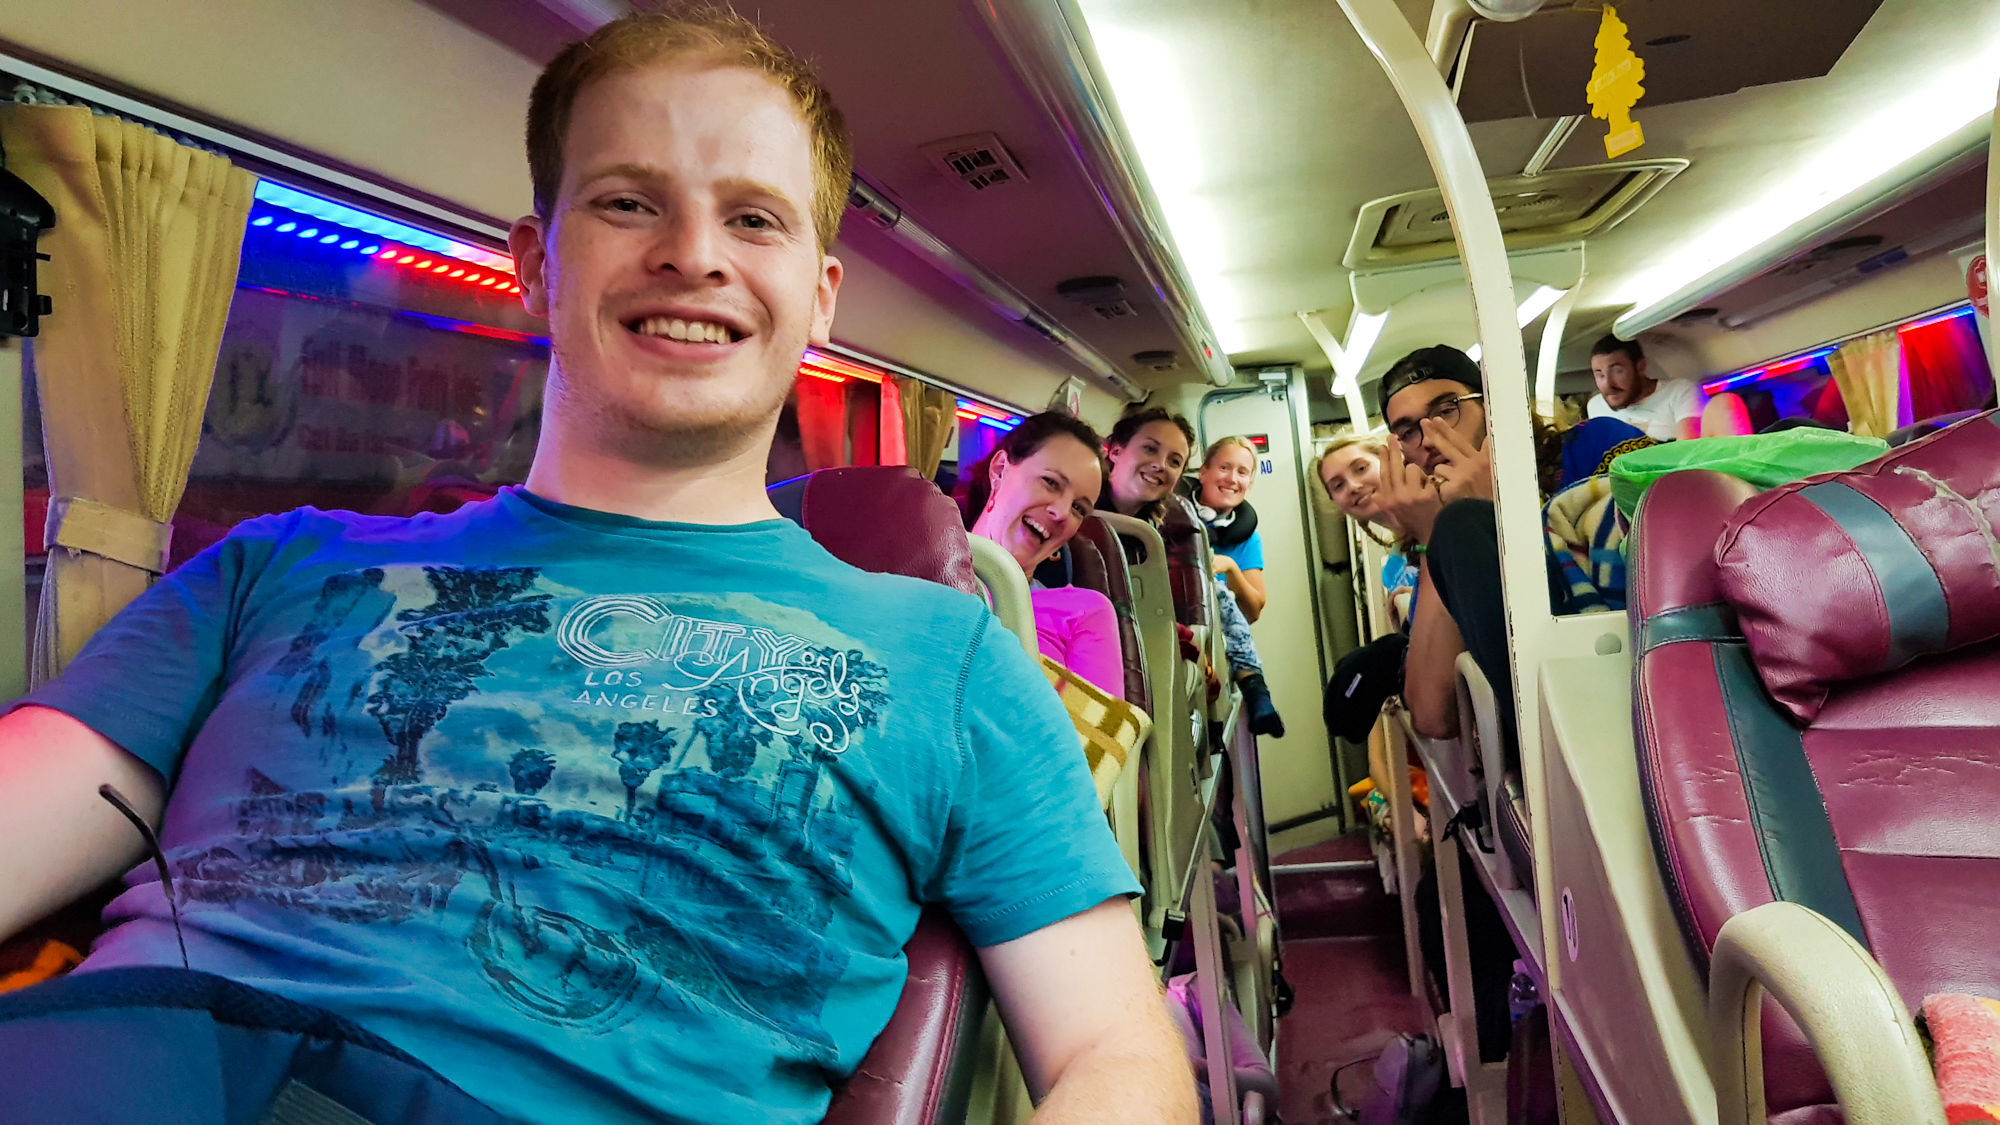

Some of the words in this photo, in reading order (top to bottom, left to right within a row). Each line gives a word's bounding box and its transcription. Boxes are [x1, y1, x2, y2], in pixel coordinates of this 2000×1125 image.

[556, 594, 814, 668] CITY
[584, 671, 643, 688] LOS
[573, 690, 719, 718] ANGELES
